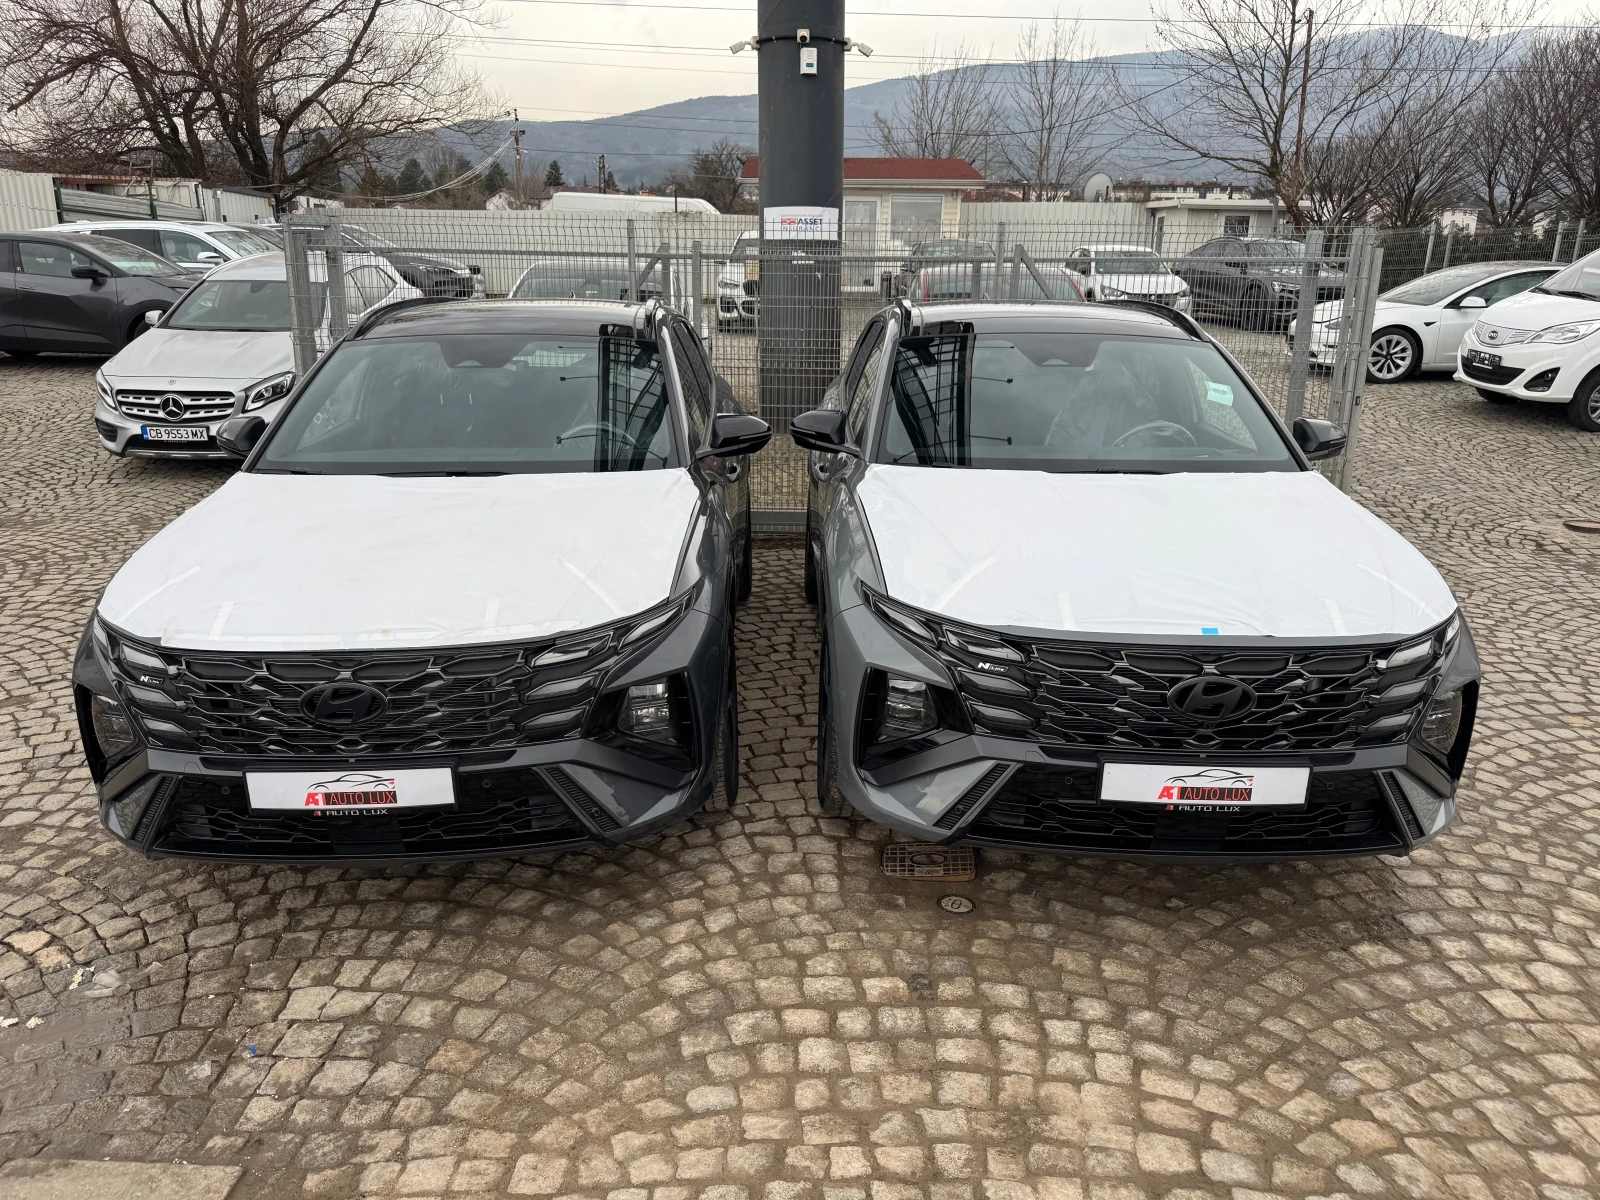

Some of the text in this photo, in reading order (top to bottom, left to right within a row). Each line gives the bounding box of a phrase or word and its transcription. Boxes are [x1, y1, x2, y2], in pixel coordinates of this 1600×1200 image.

[797, 218, 823, 226] ASSET
[148, 428, 163, 439] CB
[164, 428, 189, 439] 9553
[191, 429, 206, 440] MX
[329, 791, 365, 805] AUTO
[369, 791, 396, 804] LUX
[1183, 787, 1220, 800] AUTO
[1223, 788, 1250, 801] LUX
